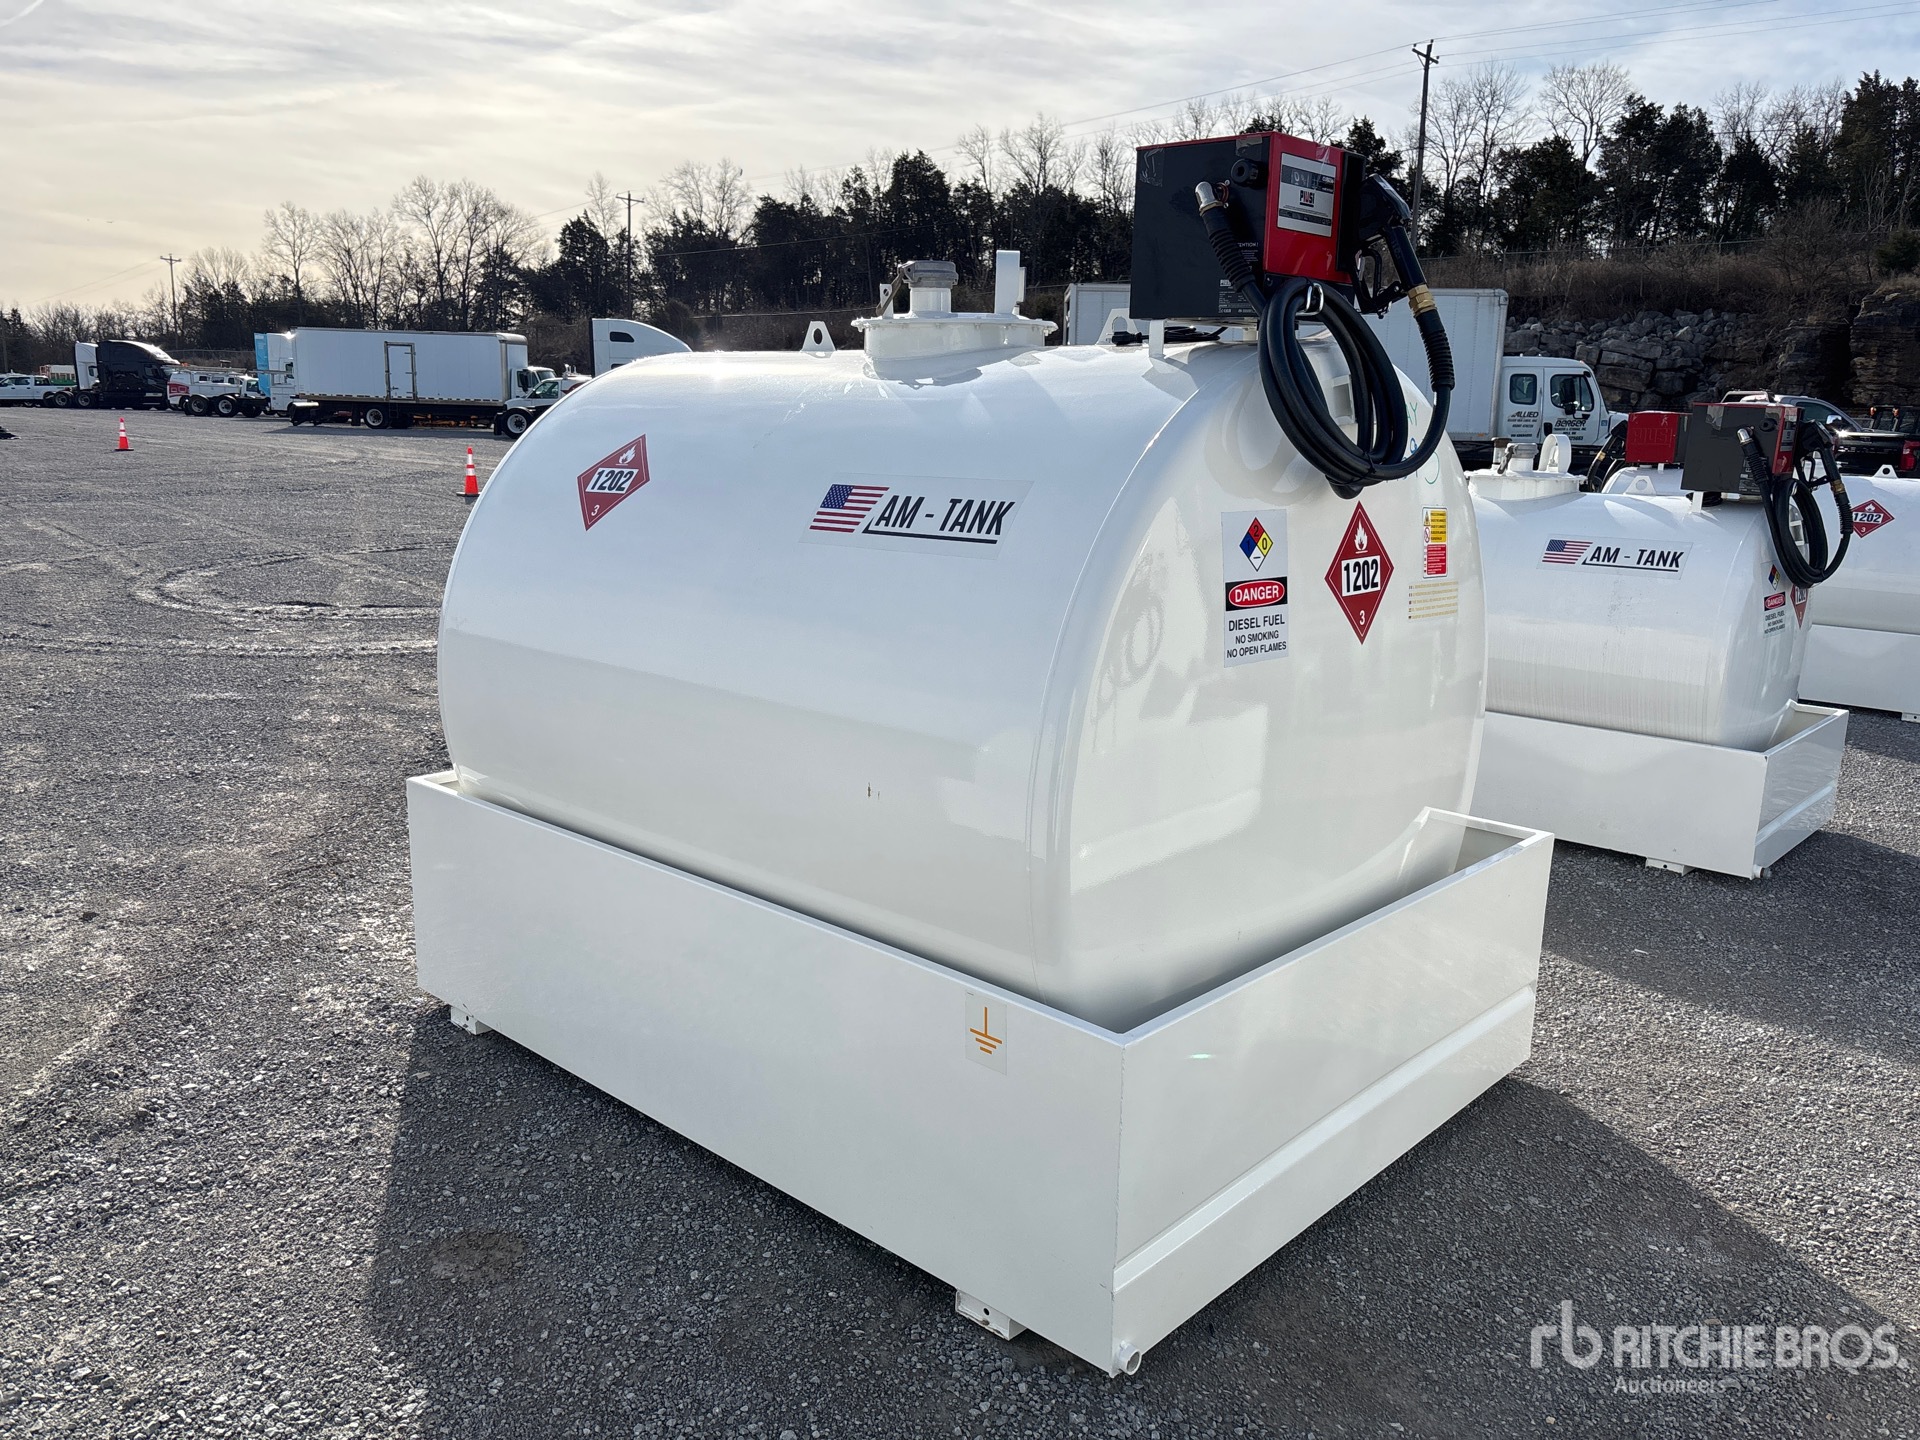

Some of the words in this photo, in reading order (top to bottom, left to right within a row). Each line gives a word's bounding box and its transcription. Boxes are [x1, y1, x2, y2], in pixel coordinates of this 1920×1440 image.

[591, 469, 635, 492] 1202
[591, 504, 600, 516] 3
[875, 495, 925, 529] AM
[939, 498, 1016, 535] TANK
[1853, 512, 1881, 523] 1202
[1253, 525, 1259, 537] 2
[1262, 538, 1268, 550] 0
[1589, 546, 1621, 563] AM
[1636, 549, 1685, 568] TANK
[1344, 558, 1379, 593] 1202
[1234, 585, 1279, 603] DANGER
[1228, 617, 1261, 632] DIESEL
[1263, 614, 1285, 627] FUEL
[1359, 610, 1366, 626] 3
[1235, 634, 1246, 644] NO
[1247, 630, 1279, 643] SMOKING
[1227, 648, 1238, 658] NO
[1239, 646, 1259, 657] OPEN
[1260, 641, 1287, 653] FLAMES
